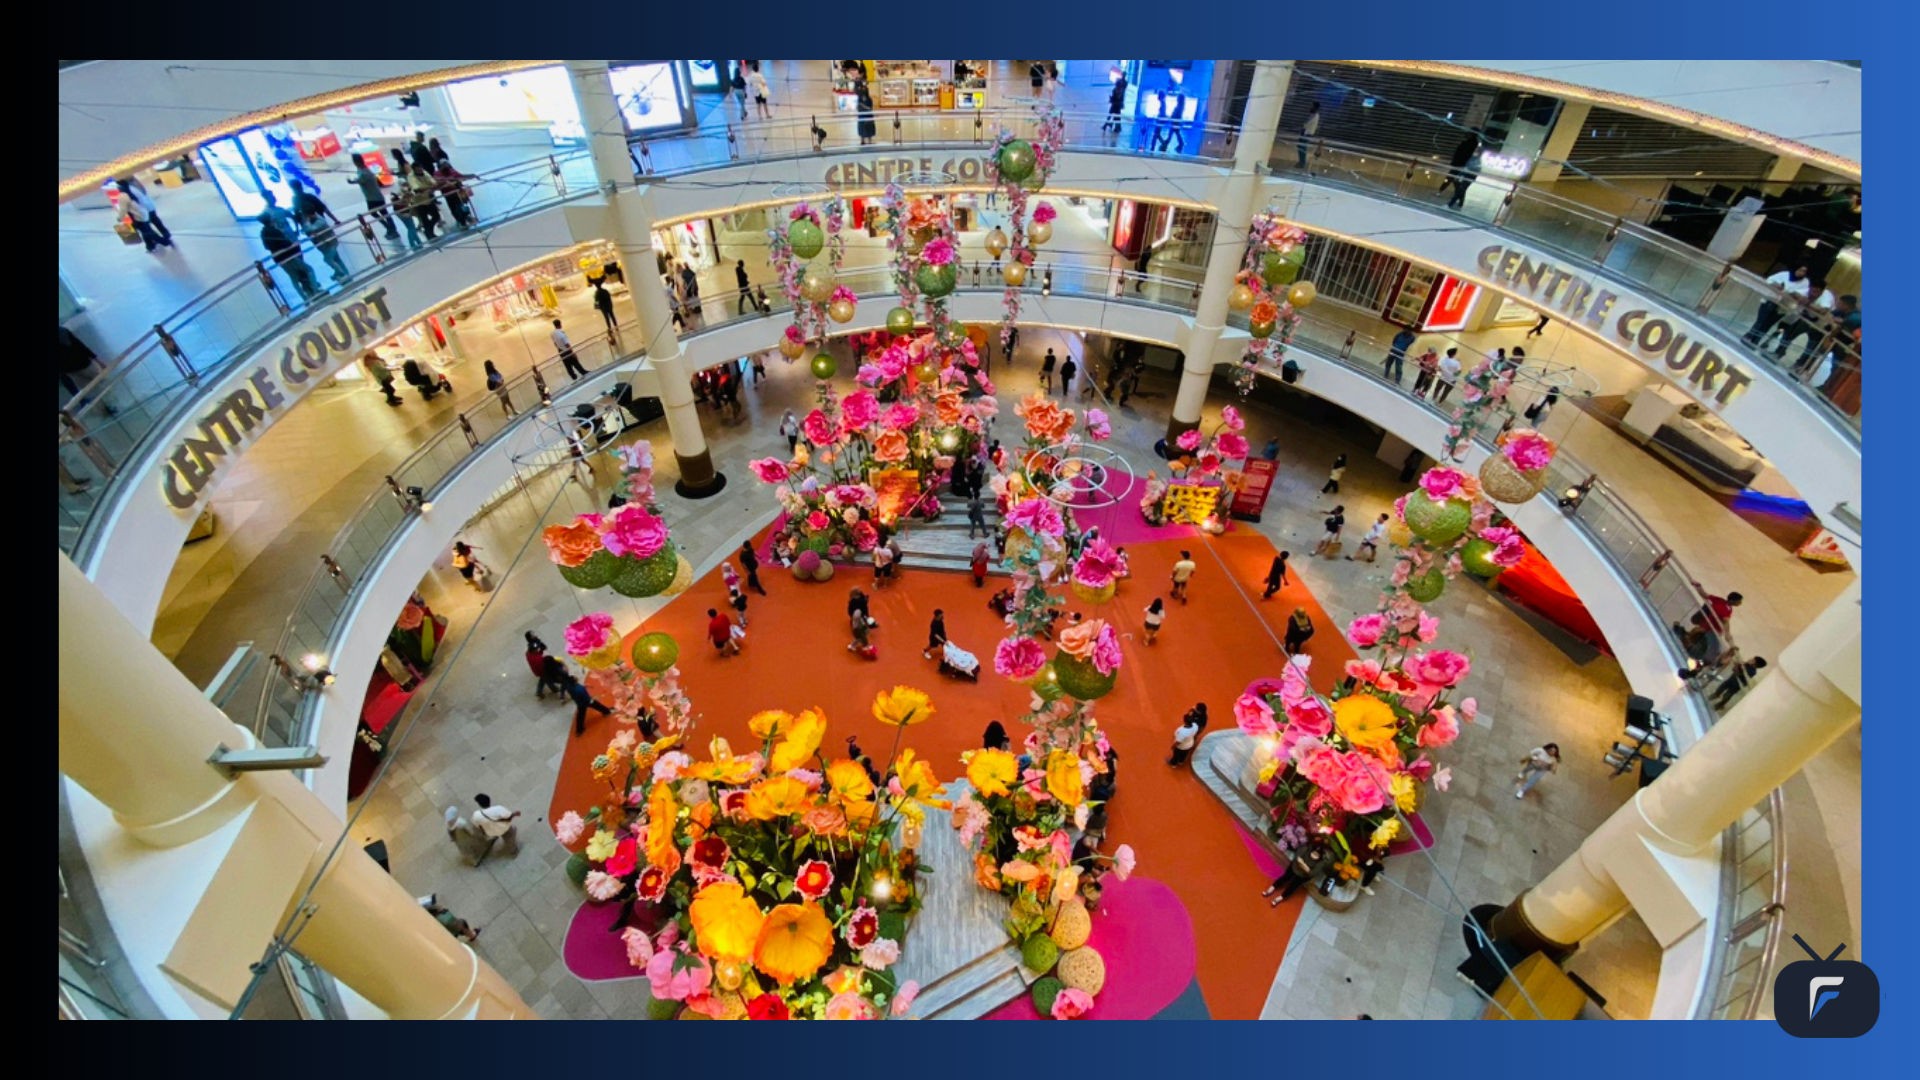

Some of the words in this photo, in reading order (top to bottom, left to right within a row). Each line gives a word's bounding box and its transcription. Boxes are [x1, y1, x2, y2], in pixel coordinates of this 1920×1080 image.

[824, 157, 933, 185] CENTRE
[161, 366, 286, 510] CENTRE
[279, 286, 392, 385] COURT
[1476, 245, 1618, 327] CENTRE
[1615, 309, 1753, 404] COURT
